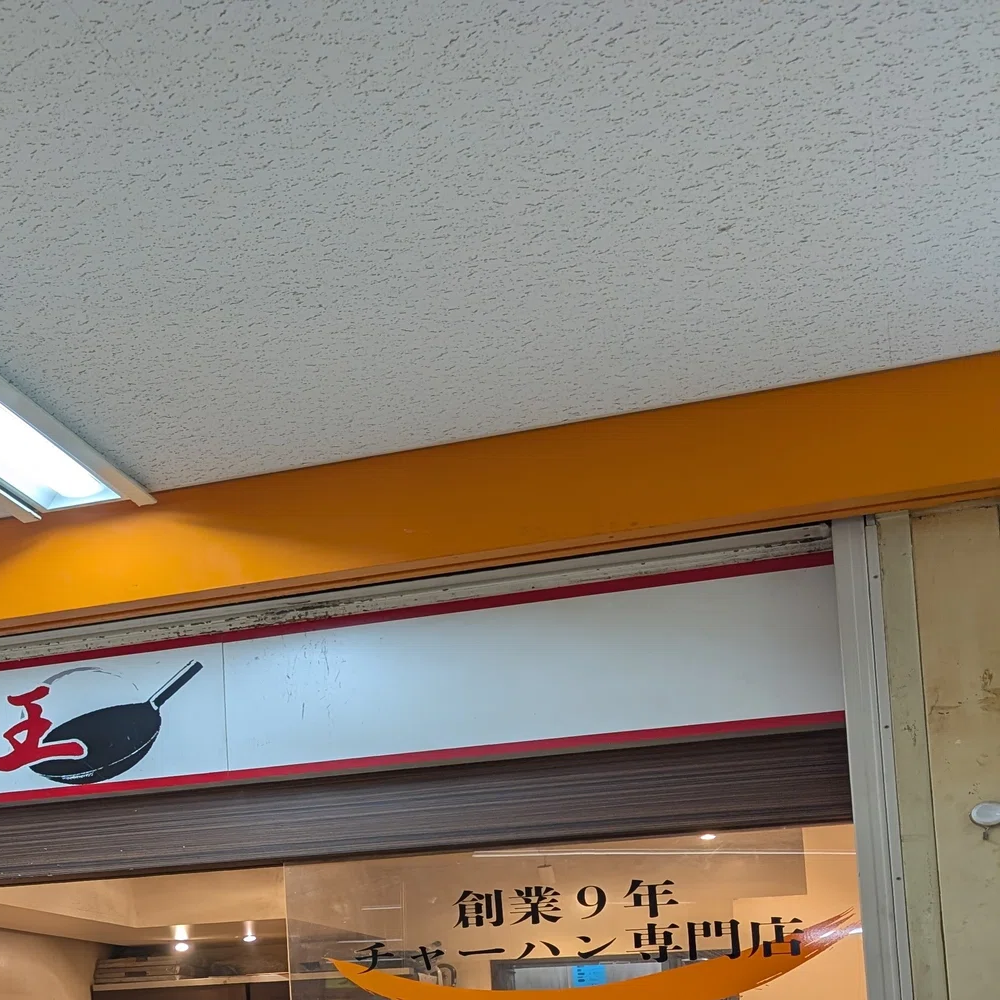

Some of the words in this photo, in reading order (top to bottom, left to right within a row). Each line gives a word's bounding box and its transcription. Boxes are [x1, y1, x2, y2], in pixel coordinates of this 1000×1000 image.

[452, 879, 679, 929] 創業9年
[356, 916, 804, 974] チャーハン専門店
